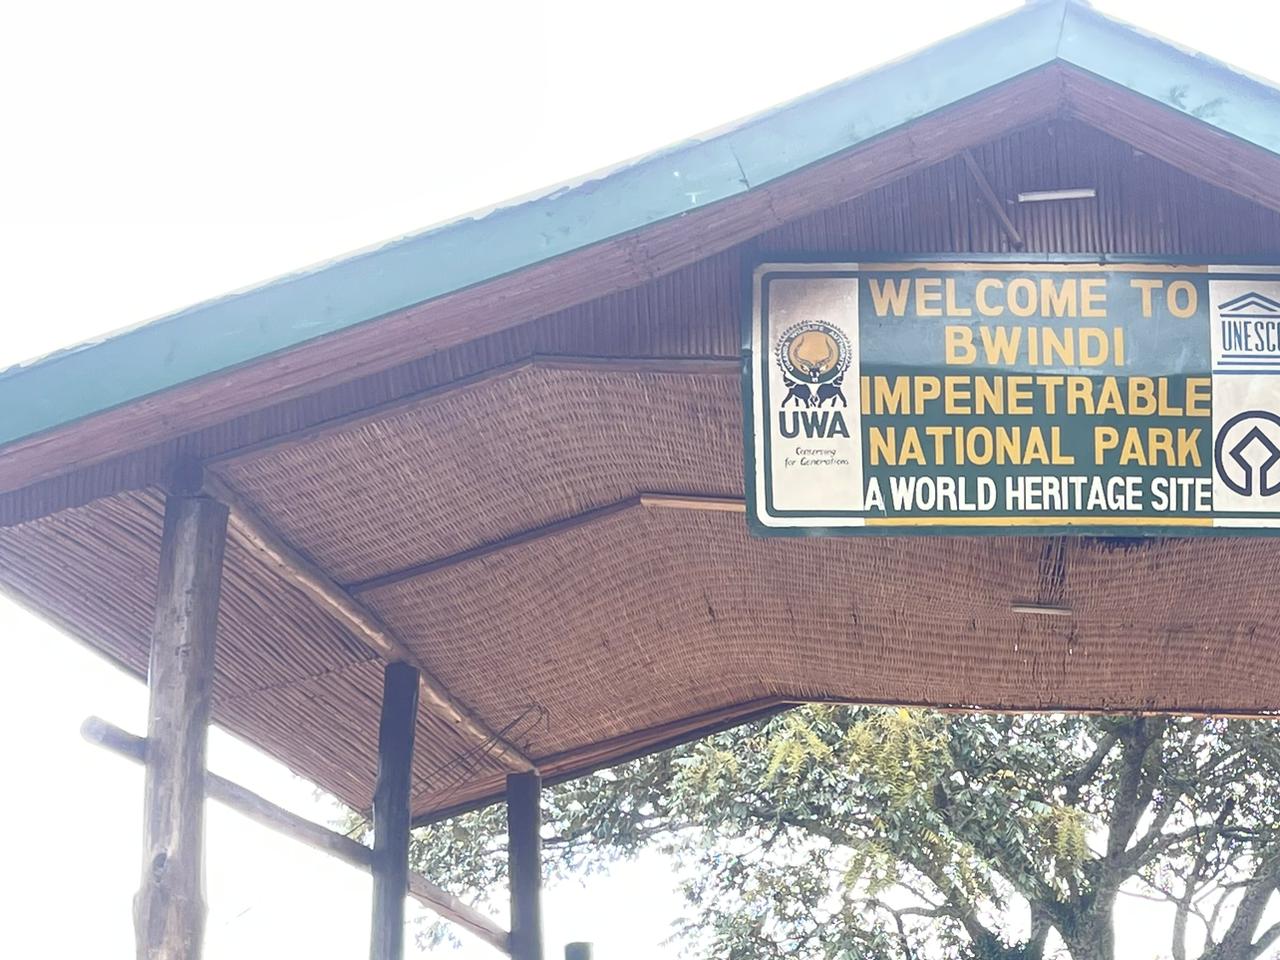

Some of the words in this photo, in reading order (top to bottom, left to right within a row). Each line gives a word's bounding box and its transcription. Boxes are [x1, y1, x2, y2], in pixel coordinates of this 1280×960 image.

[867, 278, 1107, 317] WELCOME
[1130, 279, 1198, 318] TO
[945, 326, 1125, 366] BWINDI
[861, 376, 1212, 416] IMPENETRABLE
[779, 411, 850, 438] UWA
[784, 457, 797, 468] for
[800, 457, 850, 466] Generations
[869, 426, 1075, 466] NATIONAL
[1095, 427, 1203, 467] PARK
[864, 477, 883, 512] A
[889, 477, 997, 511] WORLD
[1006, 477, 1144, 512] HERITAGE
[1152, 477, 1212, 512] SITE
